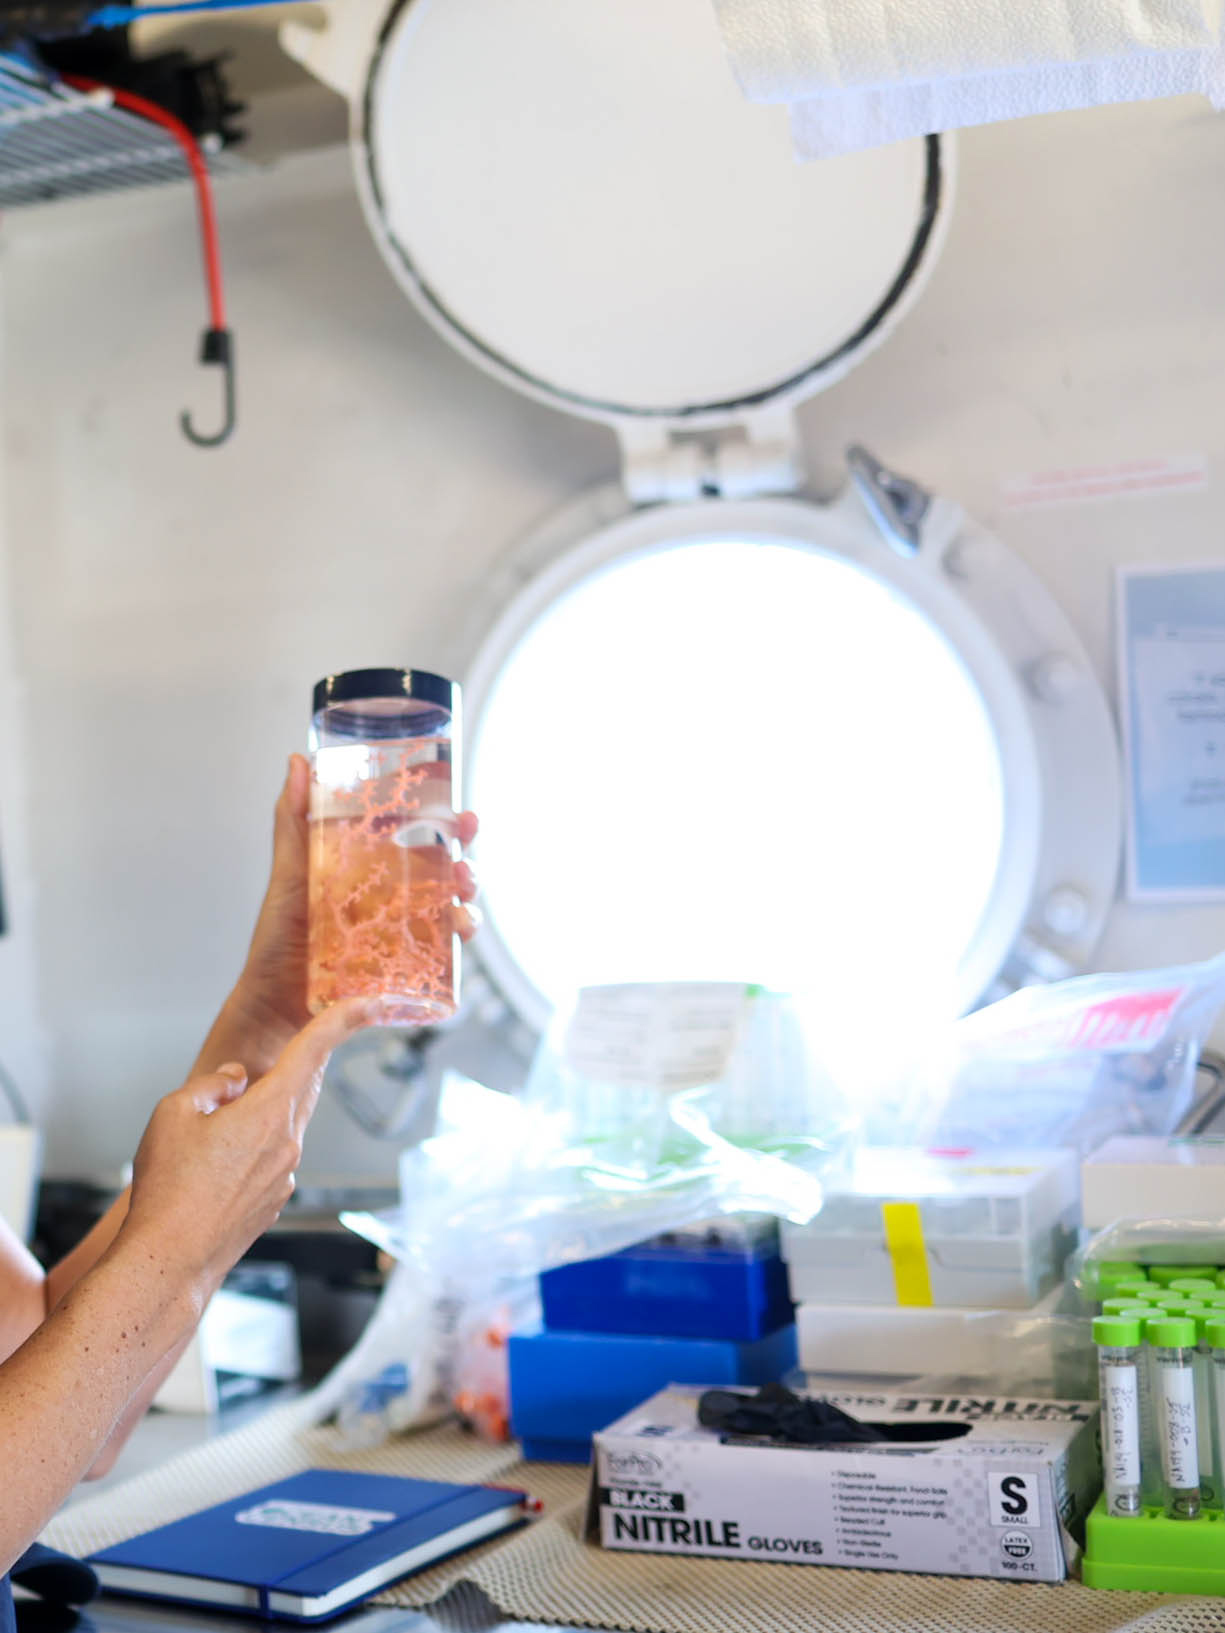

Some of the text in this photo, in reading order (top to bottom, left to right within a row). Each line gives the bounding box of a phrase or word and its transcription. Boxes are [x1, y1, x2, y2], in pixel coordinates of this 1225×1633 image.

[609, 1489, 675, 1511] BLACK
[1000, 1476, 1028, 1516] S
[1001, 1516, 1028, 1524] SMALL
[613, 1513, 824, 1555] NITRILE GLOVES
[1005, 1536, 1028, 1544] LATEX
